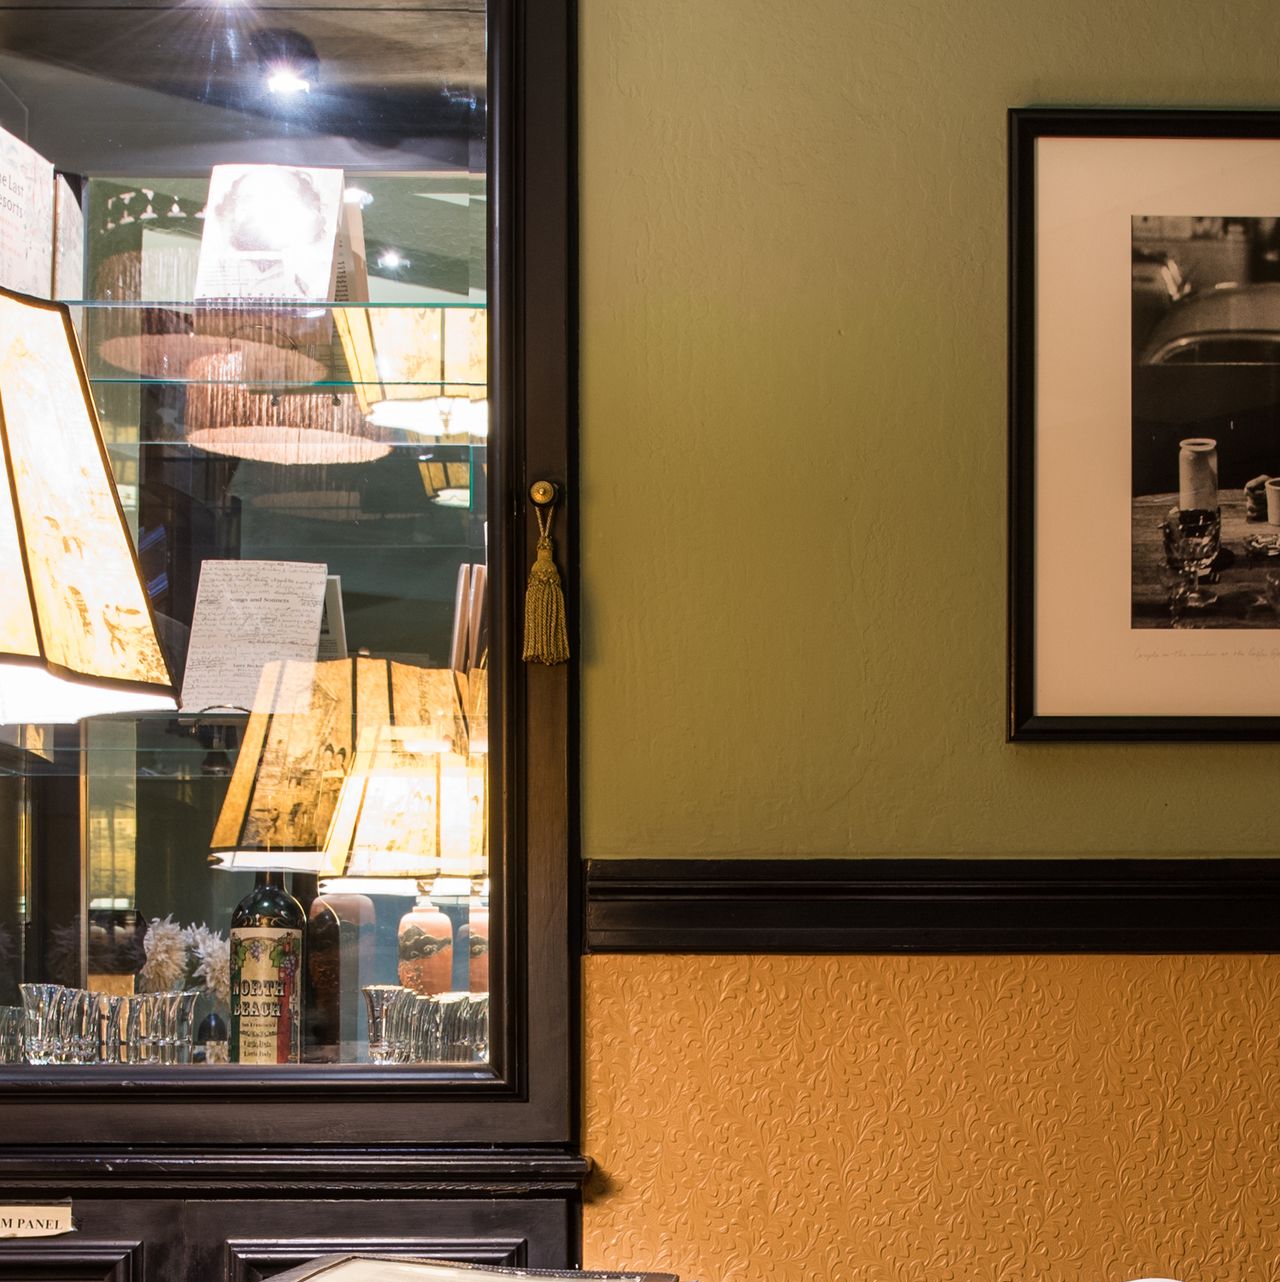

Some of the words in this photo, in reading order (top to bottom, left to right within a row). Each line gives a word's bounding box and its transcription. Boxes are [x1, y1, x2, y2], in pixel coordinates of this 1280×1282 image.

[8, 174, 24, 199] Last
[232, 979, 287, 997] NORTH
[233, 1001, 282, 1017] BEACH
[17, 1219, 64, 1230] PANEL
